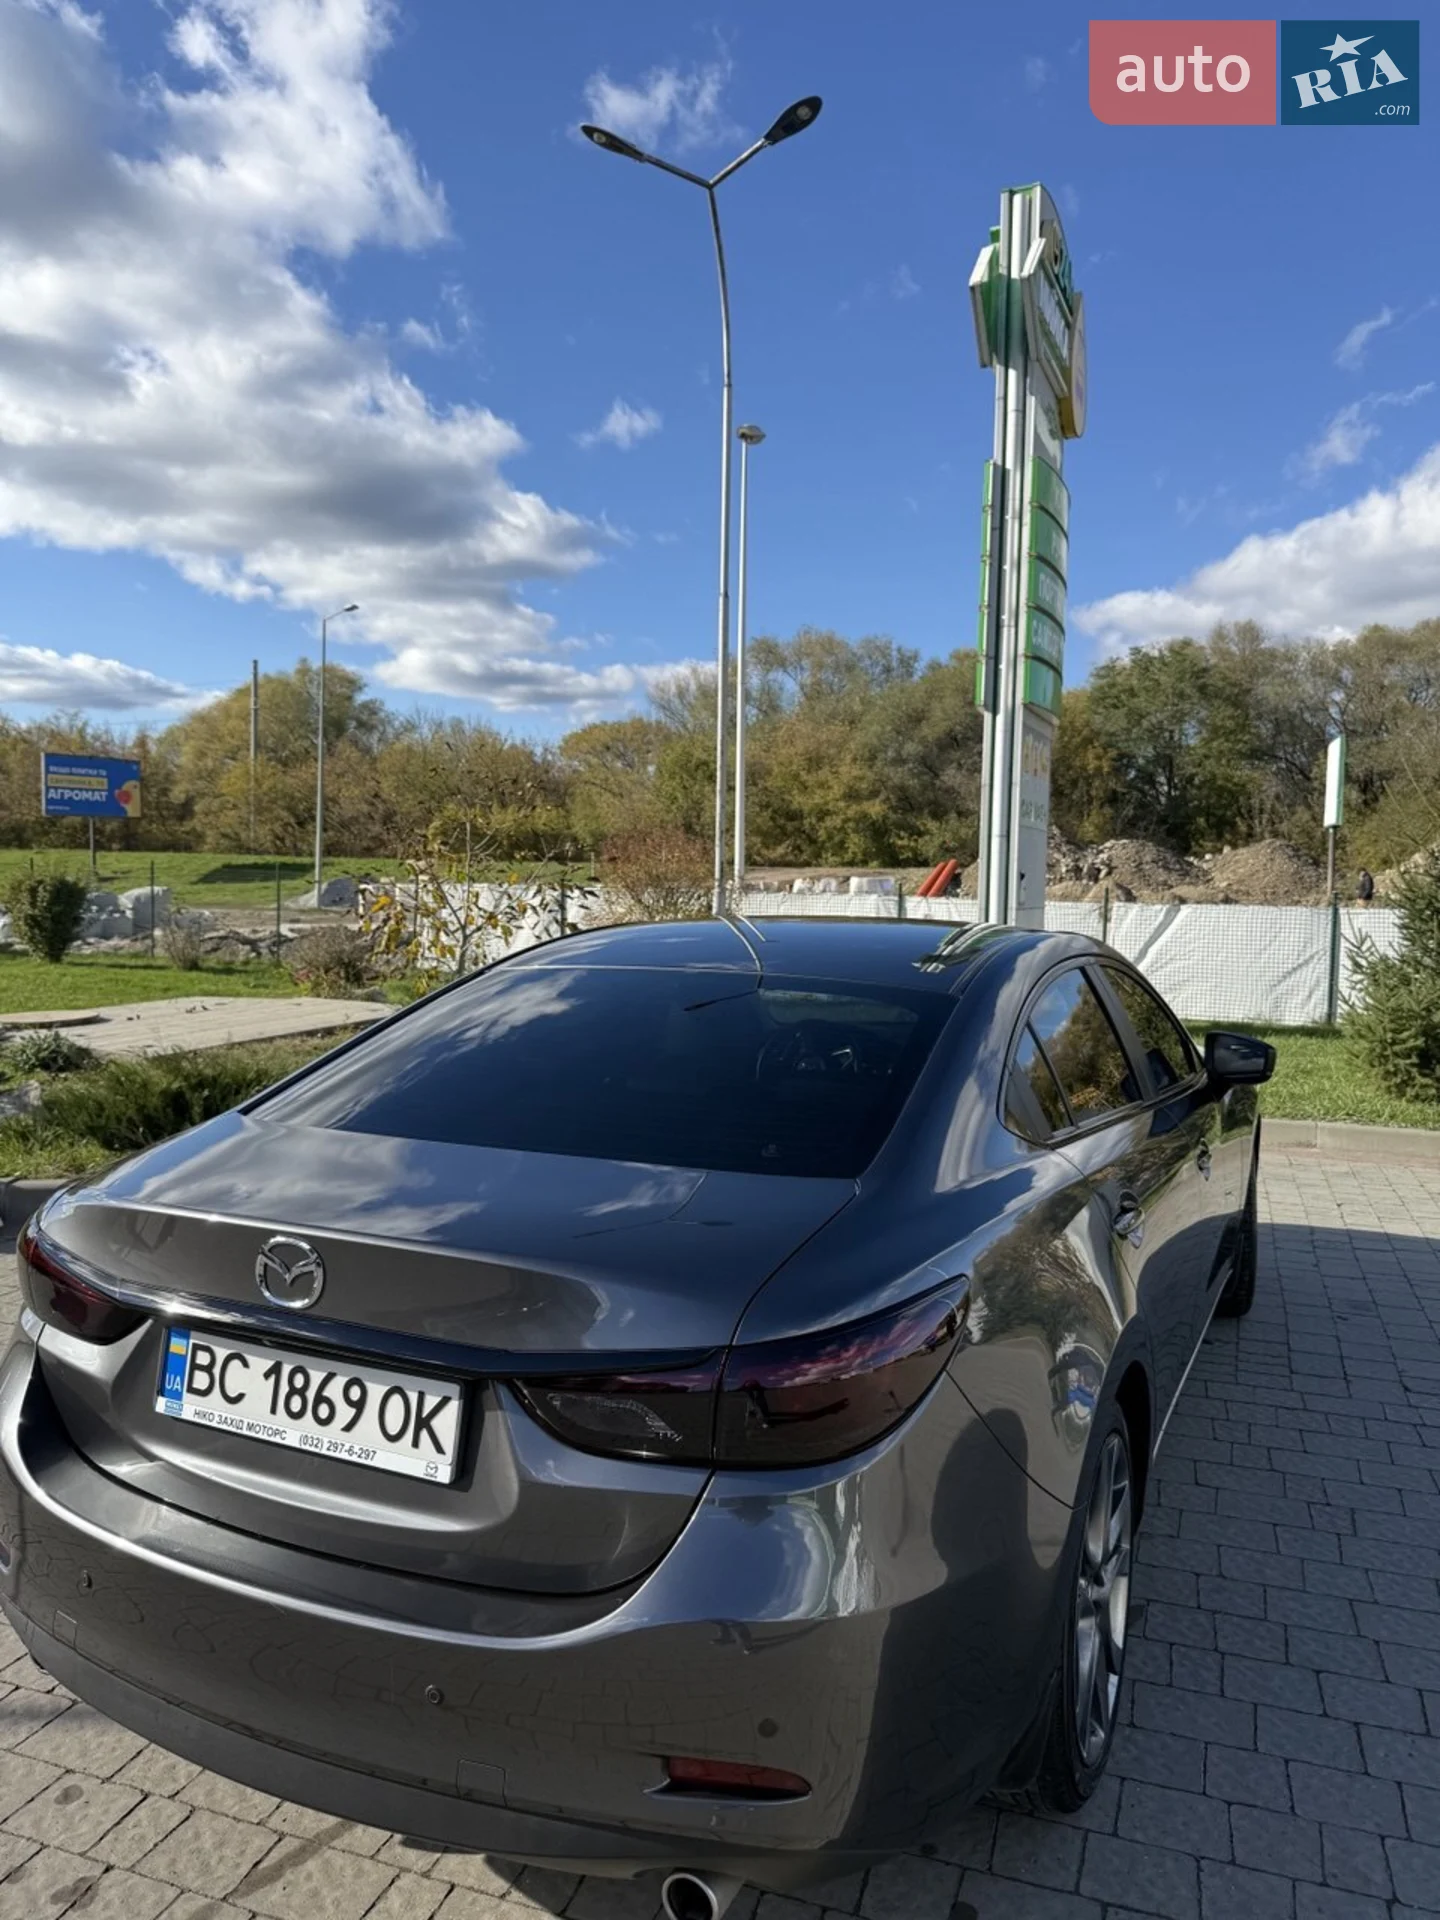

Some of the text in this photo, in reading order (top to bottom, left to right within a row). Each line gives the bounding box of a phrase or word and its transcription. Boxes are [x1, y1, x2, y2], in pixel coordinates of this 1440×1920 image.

[47, 788, 108, 802] АГРОМАТ
[165, 1373, 182, 1393] UA
[186, 1341, 452, 1456] BC 1869 OK
[193, 1408, 215, 1423] НІКО
[216, 1414, 244, 1431] ЗАХІД
[246, 1421, 288, 1441] МОТОРС
[299, 1433, 377, 1461] (032) 297-6-297
